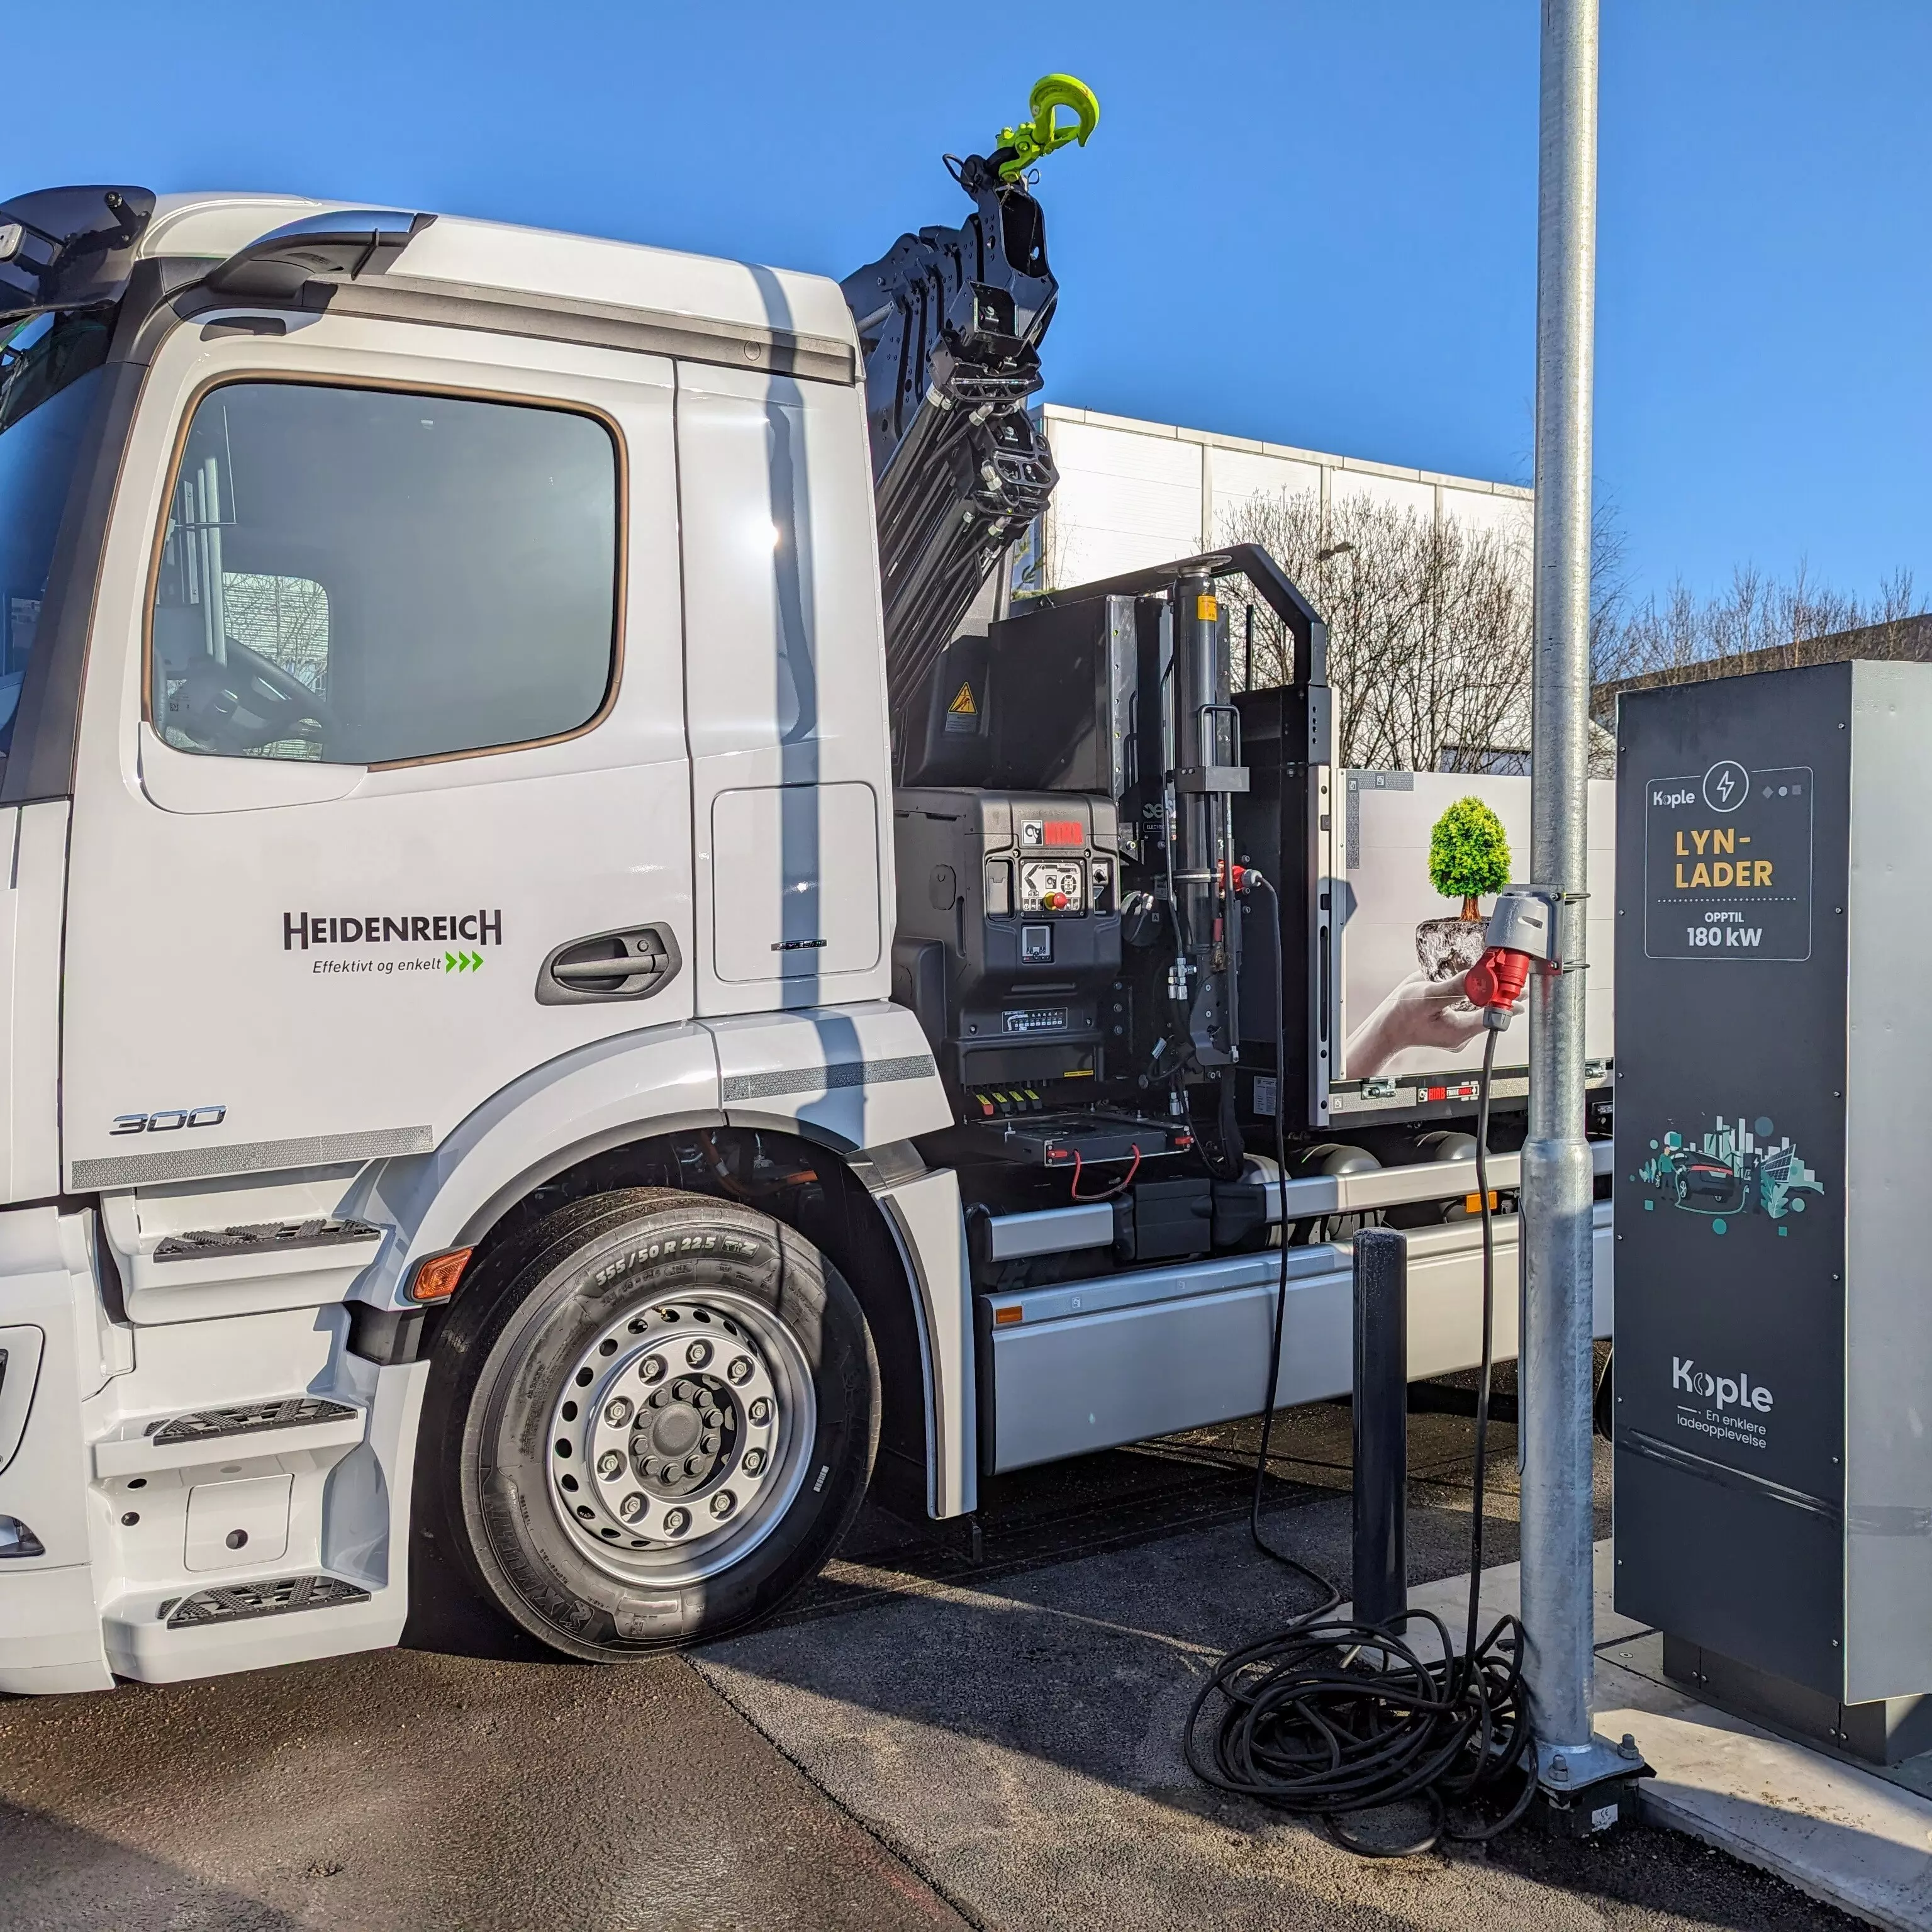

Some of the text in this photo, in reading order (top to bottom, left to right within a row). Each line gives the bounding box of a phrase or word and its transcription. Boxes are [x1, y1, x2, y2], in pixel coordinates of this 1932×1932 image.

[1653, 789, 1695, 808] Kople
[1677, 828, 1751, 856] LYN-
[1676, 861, 1773, 888] LADER
[284, 909, 502, 951] HEIDENREICH
[1705, 912, 1745, 923] OPPTIL
[1687, 927, 1763, 947] 180 kW
[313, 958, 442, 975] Effektivt og enkelt
[1429, 1087, 1446, 1101] HIAB
[109, 1105, 228, 1136] 300
[664, 1241, 677, 1254] R
[681, 1237, 717, 1251] 22.5
[1673, 1356, 1773, 1413] Kople
[1677, 1413, 1767, 1448] ladeopplevelse
[1706, 1409, 1767, 1436] En enklere
